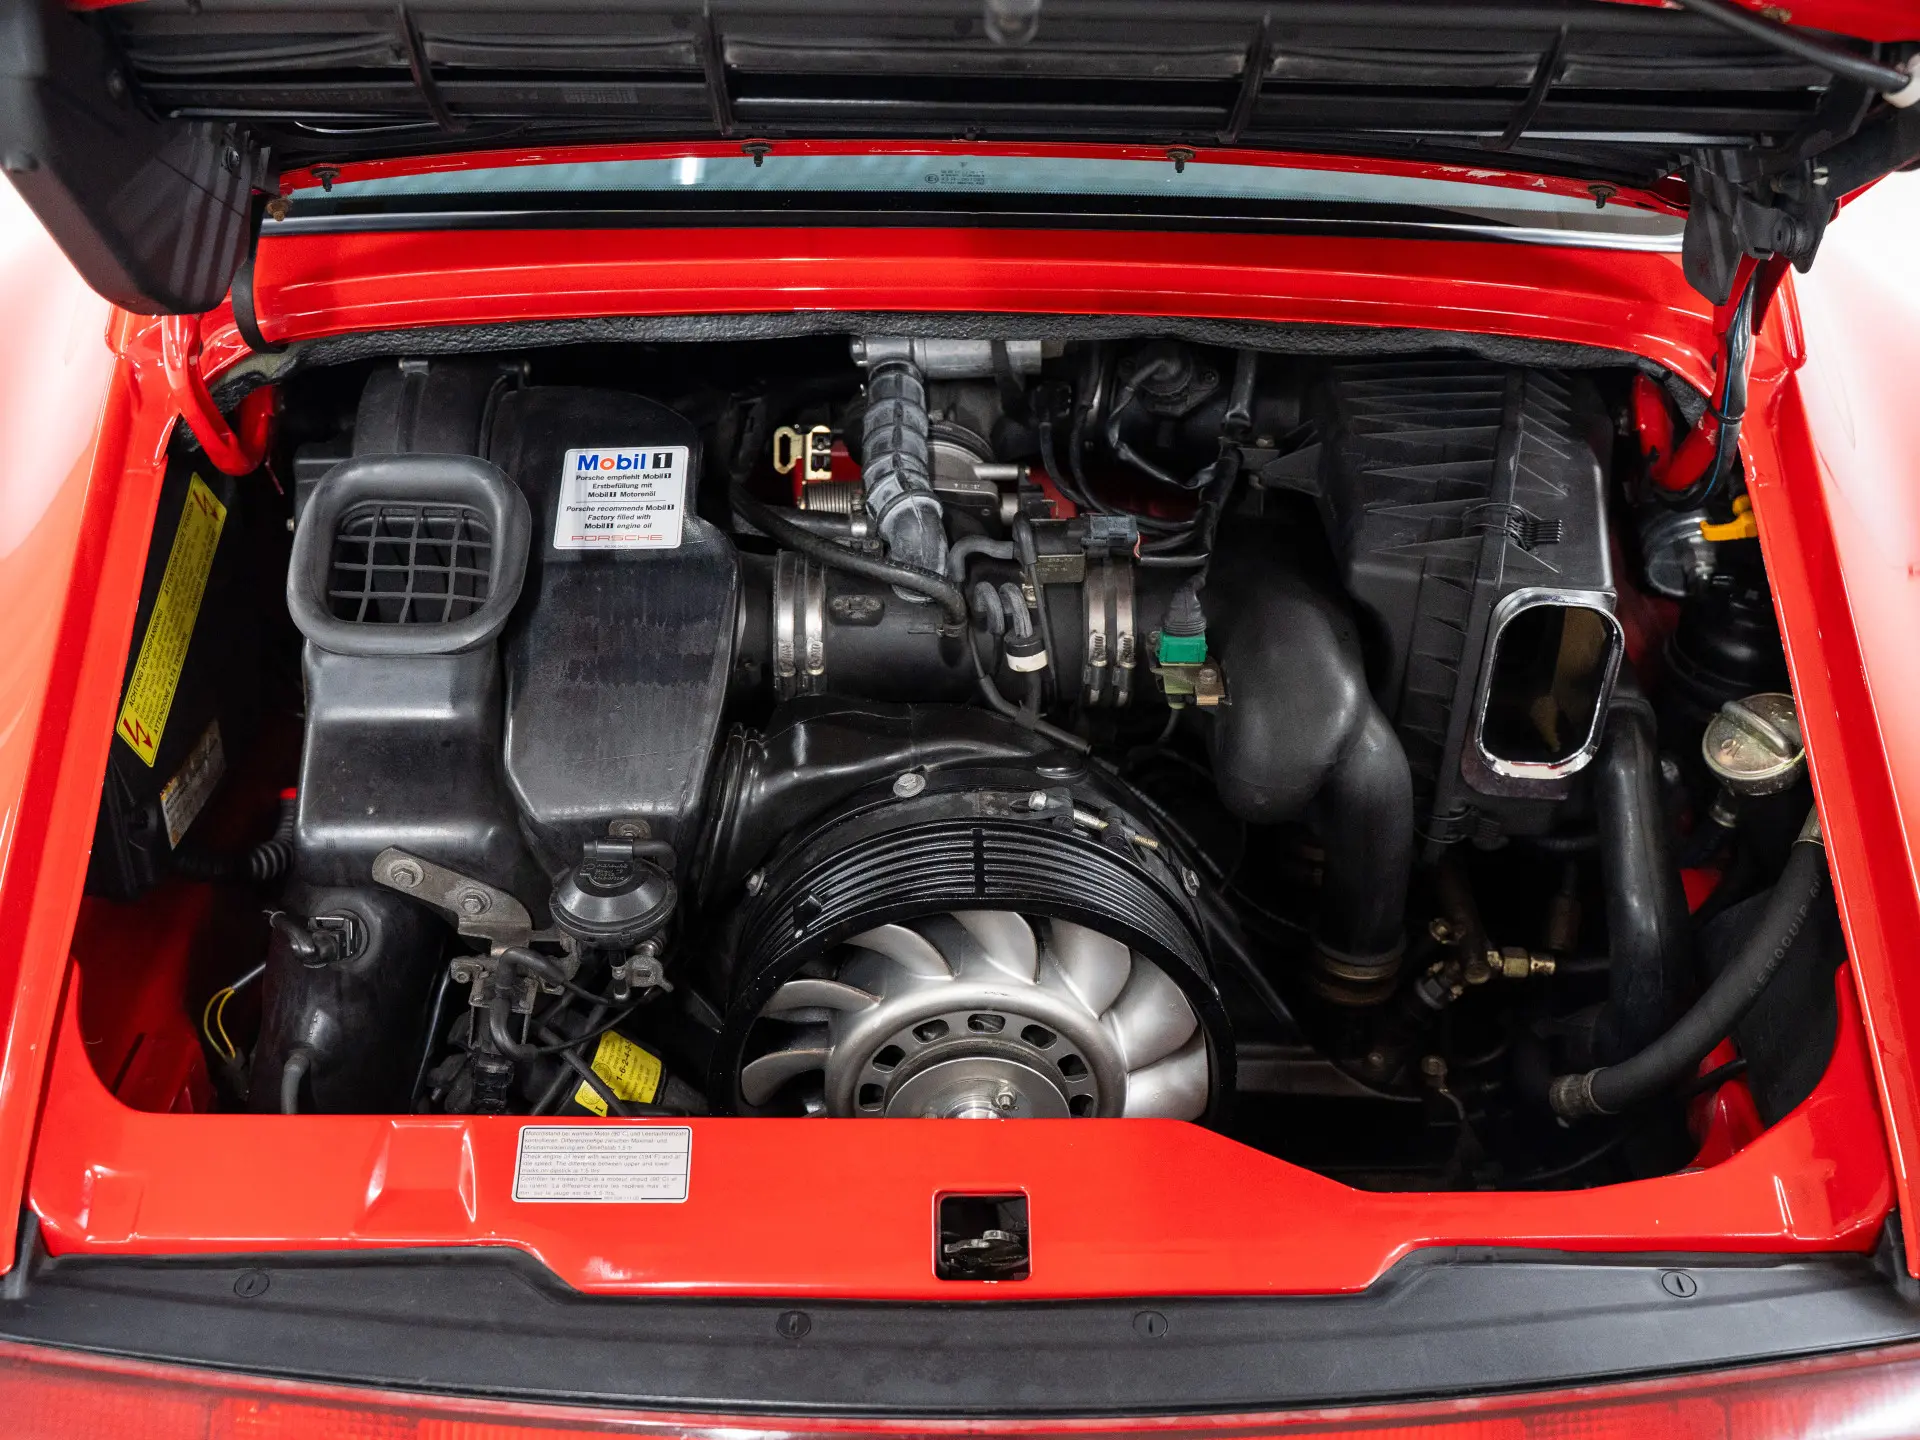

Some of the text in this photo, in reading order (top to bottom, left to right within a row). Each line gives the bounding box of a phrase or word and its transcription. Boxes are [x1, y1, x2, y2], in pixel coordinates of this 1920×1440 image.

[577, 453, 670, 470] Mobil 1
[128, 606, 163, 708] ACHTUNG HOCHSPANNUNG
[153, 686, 170, 735] ATTENZIONE
[167, 666, 176, 688] ALTA
